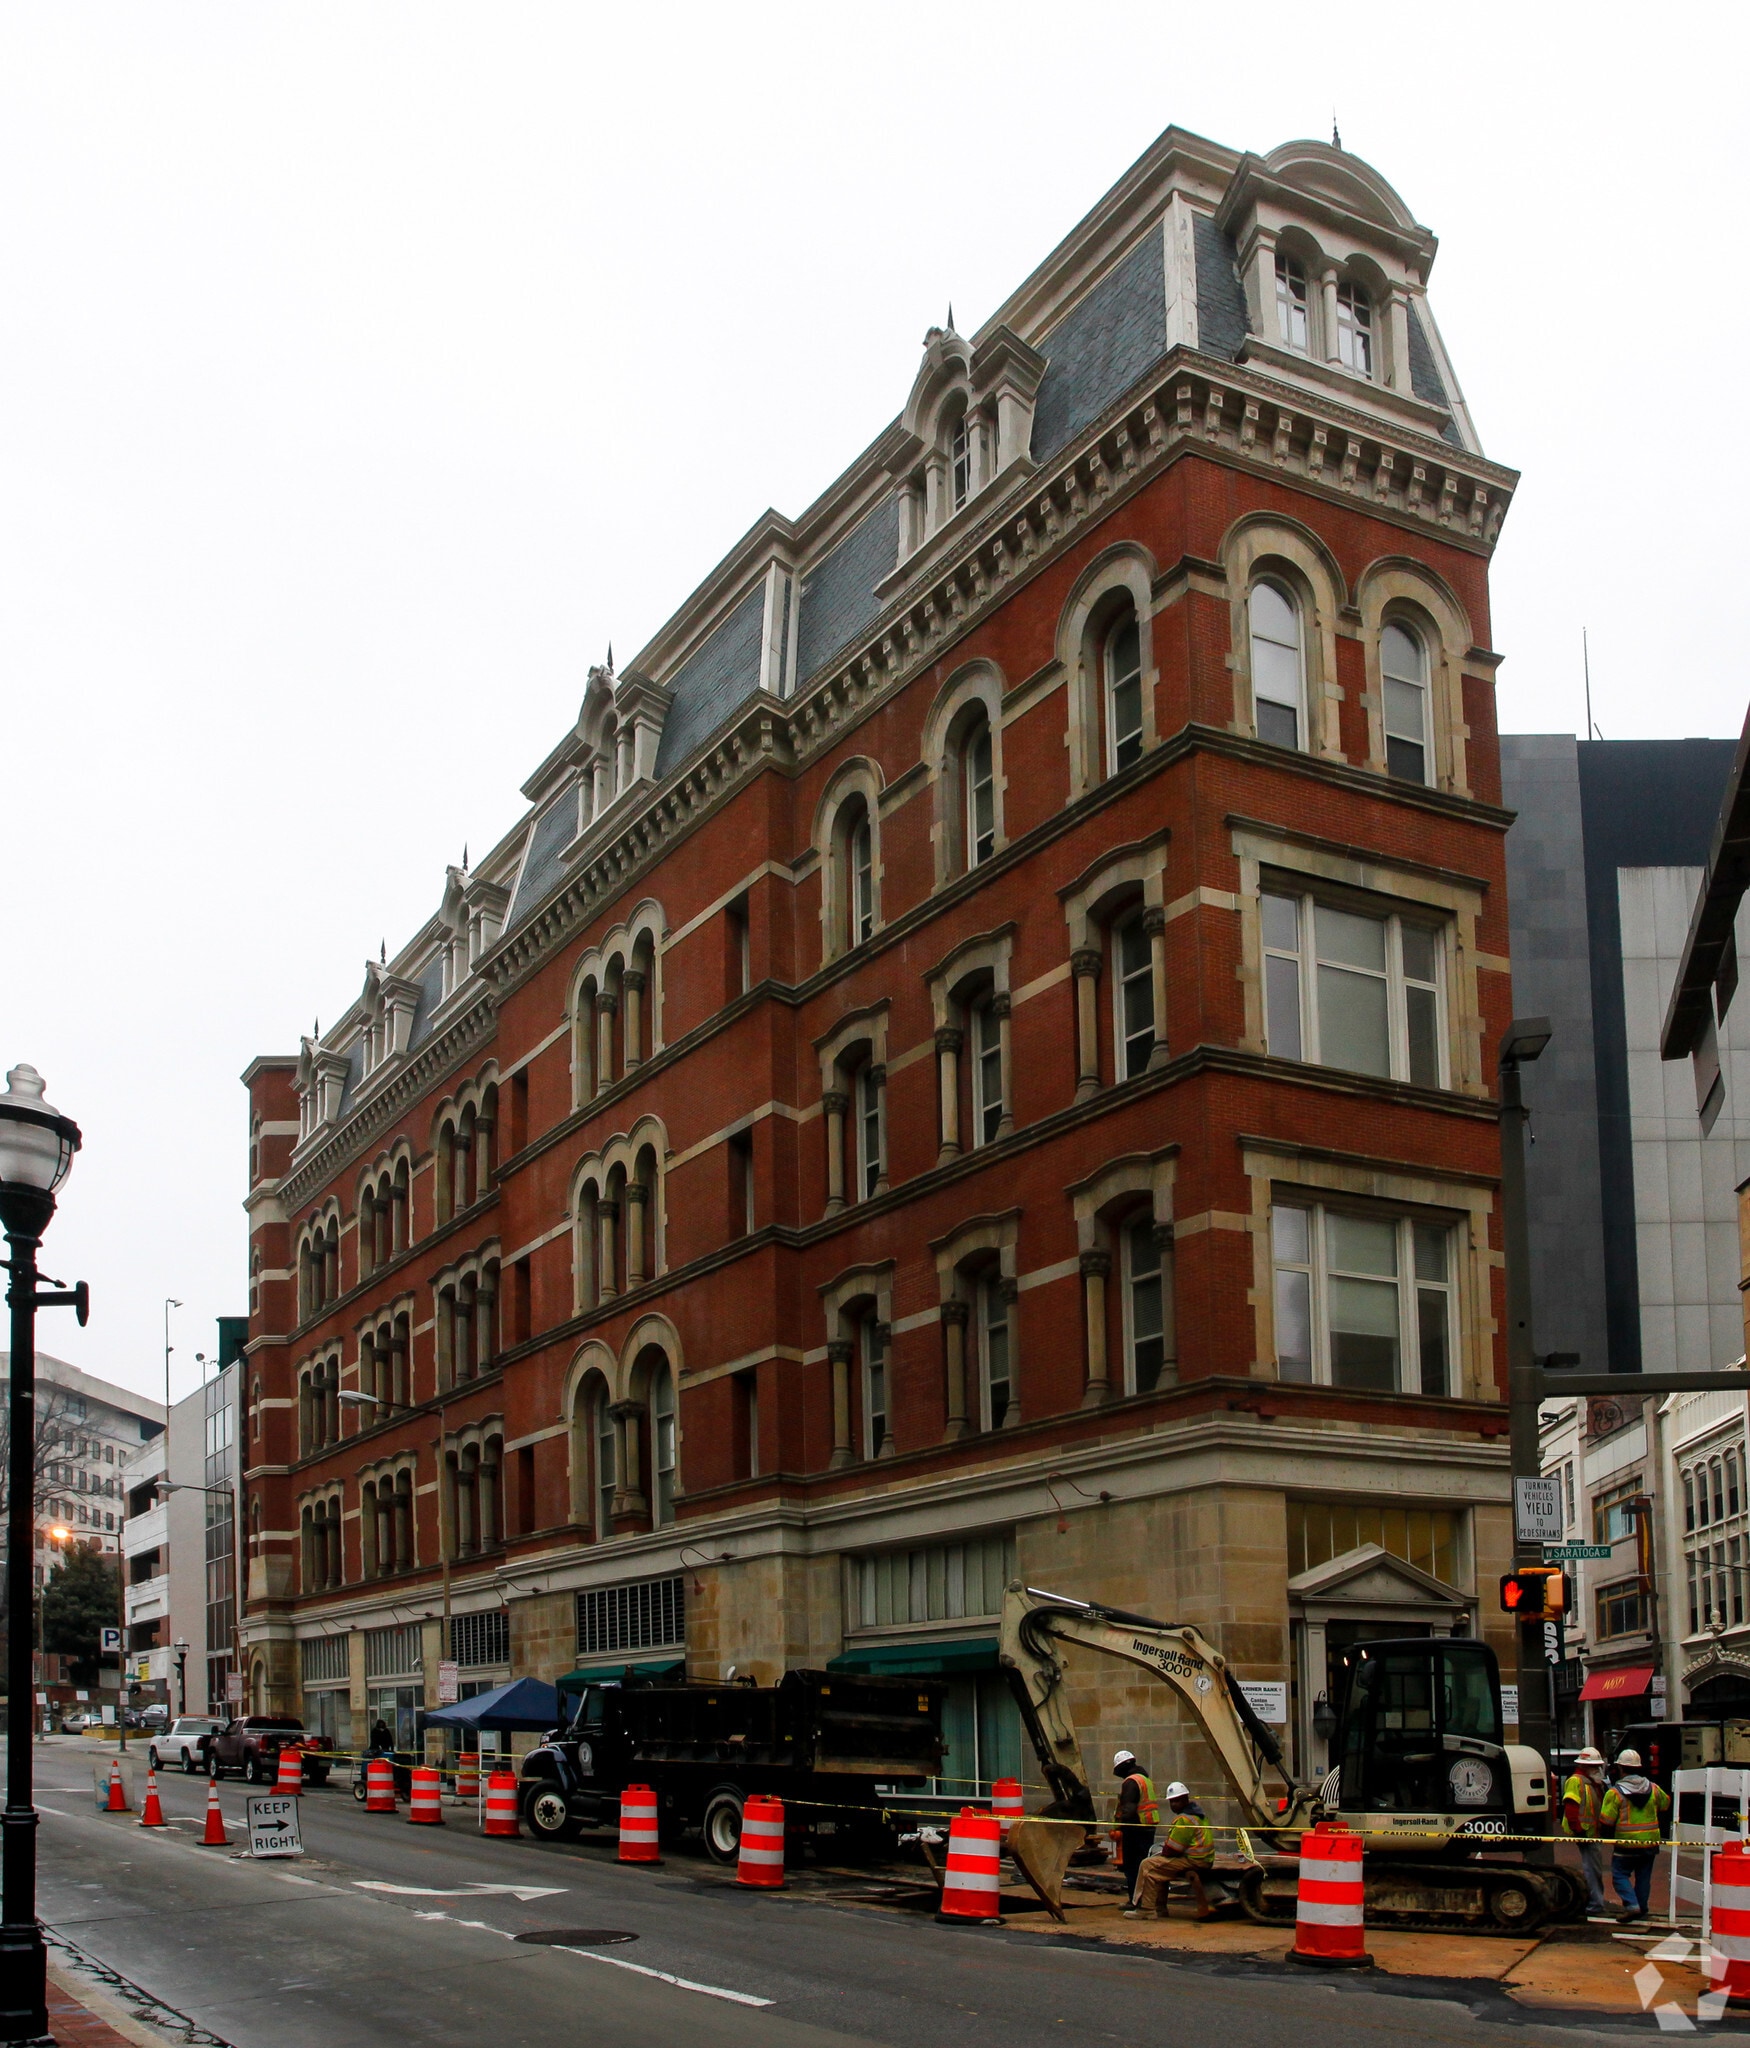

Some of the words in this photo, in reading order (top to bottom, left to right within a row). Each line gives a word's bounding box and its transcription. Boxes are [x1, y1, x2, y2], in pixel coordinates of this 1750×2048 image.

[1525, 1481, 1552, 1491] TURNING
[1524, 1492, 1554, 1501] VEHICLES
[1526, 1502, 1553, 1515] YIELD
[1536, 1518, 1544, 1527] TO
[1520, 1528, 1560, 1538] PEDESTRIANS
[1545, 1548, 1553, 1558] W
[1554, 1548, 1600, 1558] SARATOGA
[104, 1629, 120, 1647] P
[1157, 1658, 1192, 1678] 3000
[254, 1802, 291, 1815] KEEP
[1464, 1821, 1506, 1834] 3000
[255, 1836, 296, 1849] RIGHT
[1438, 1833, 1483, 1841] CAUTION
